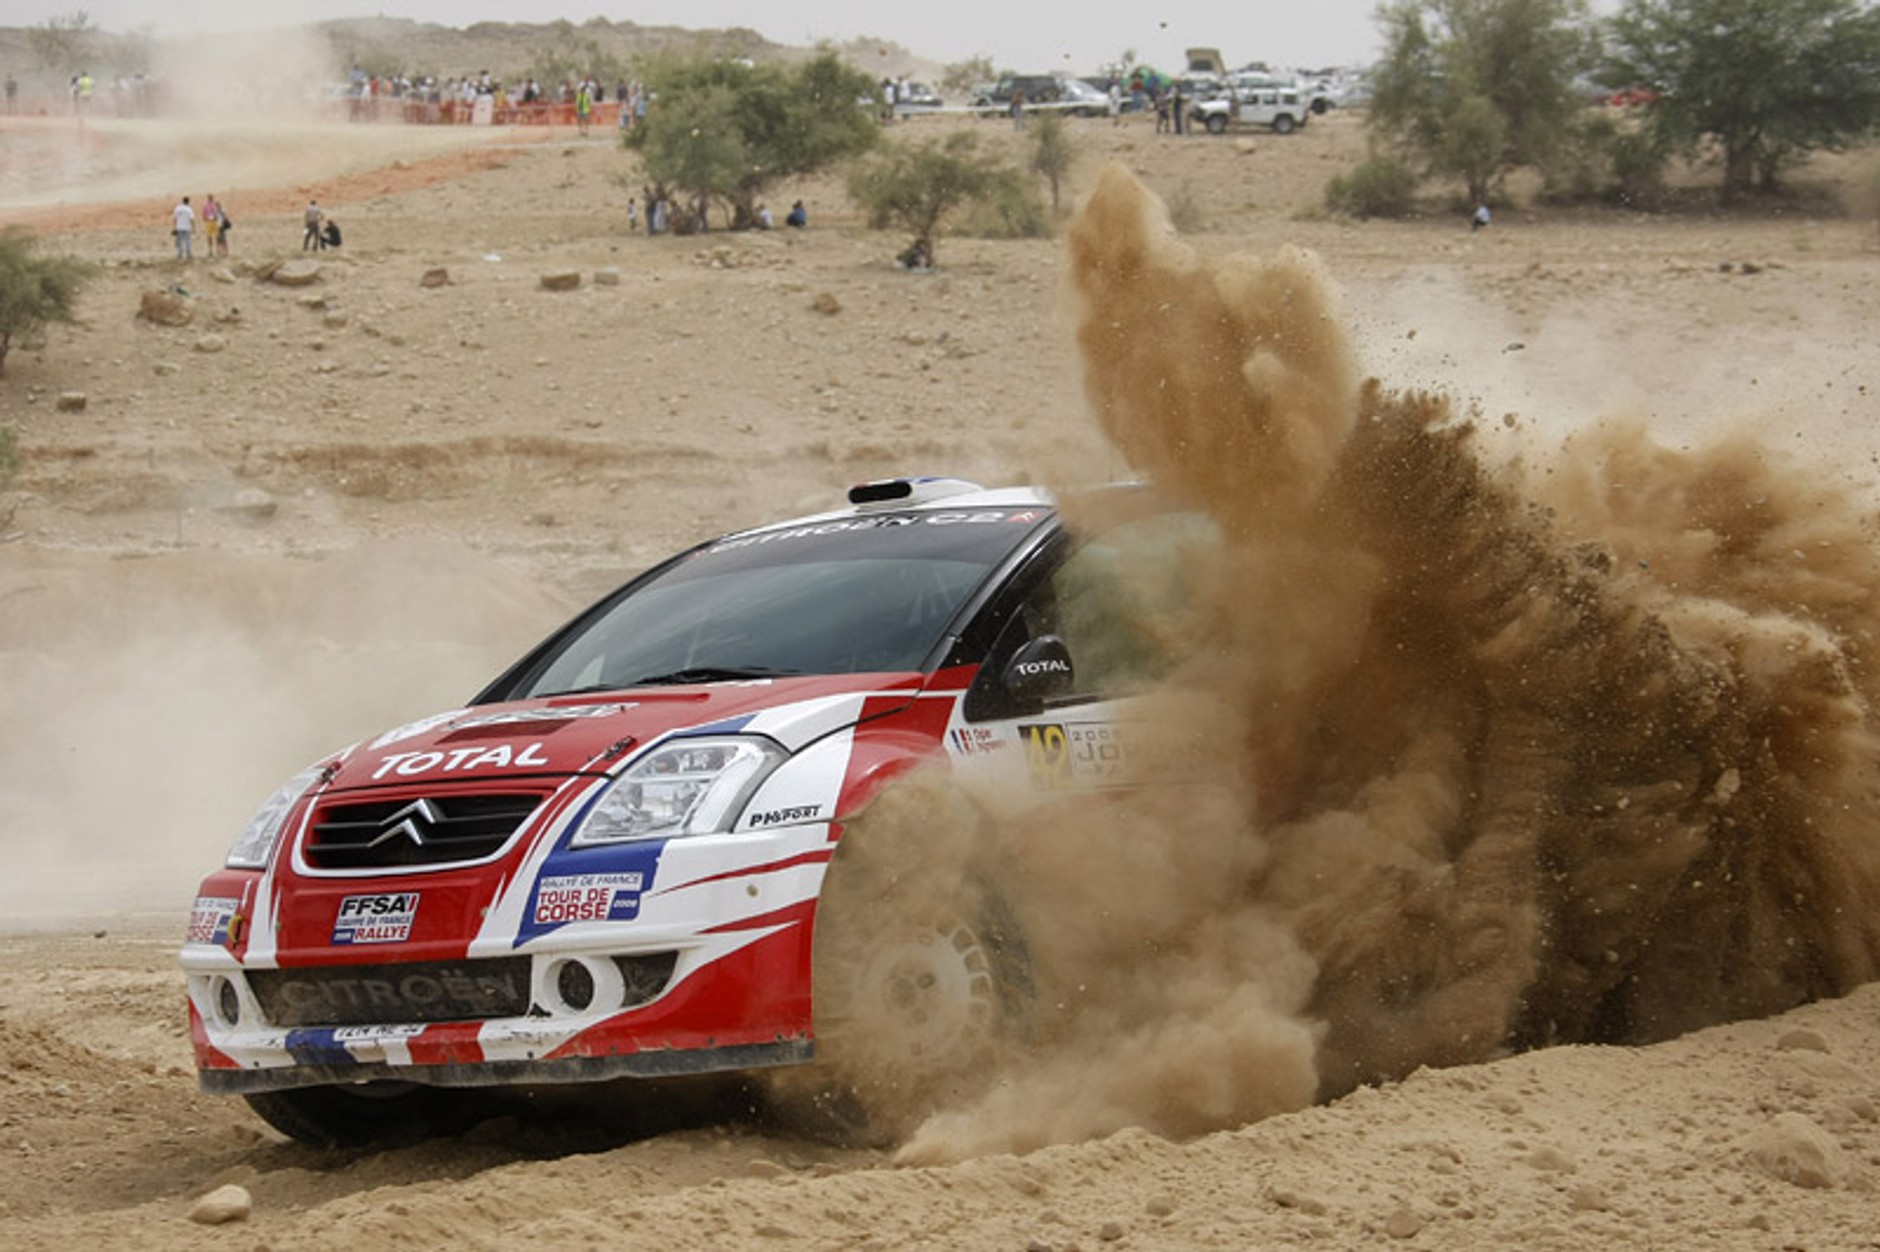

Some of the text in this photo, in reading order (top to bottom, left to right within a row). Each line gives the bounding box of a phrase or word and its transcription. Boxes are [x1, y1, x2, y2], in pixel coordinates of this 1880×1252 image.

[1016, 659, 1070, 676] TOTAL
[371, 742, 549, 780] TOTAL
[340, 894, 406, 917] FFSA
[539, 887, 610, 905] TOUR DE
[535, 901, 608, 923] CORSE
[354, 924, 408, 941] RALLYE
